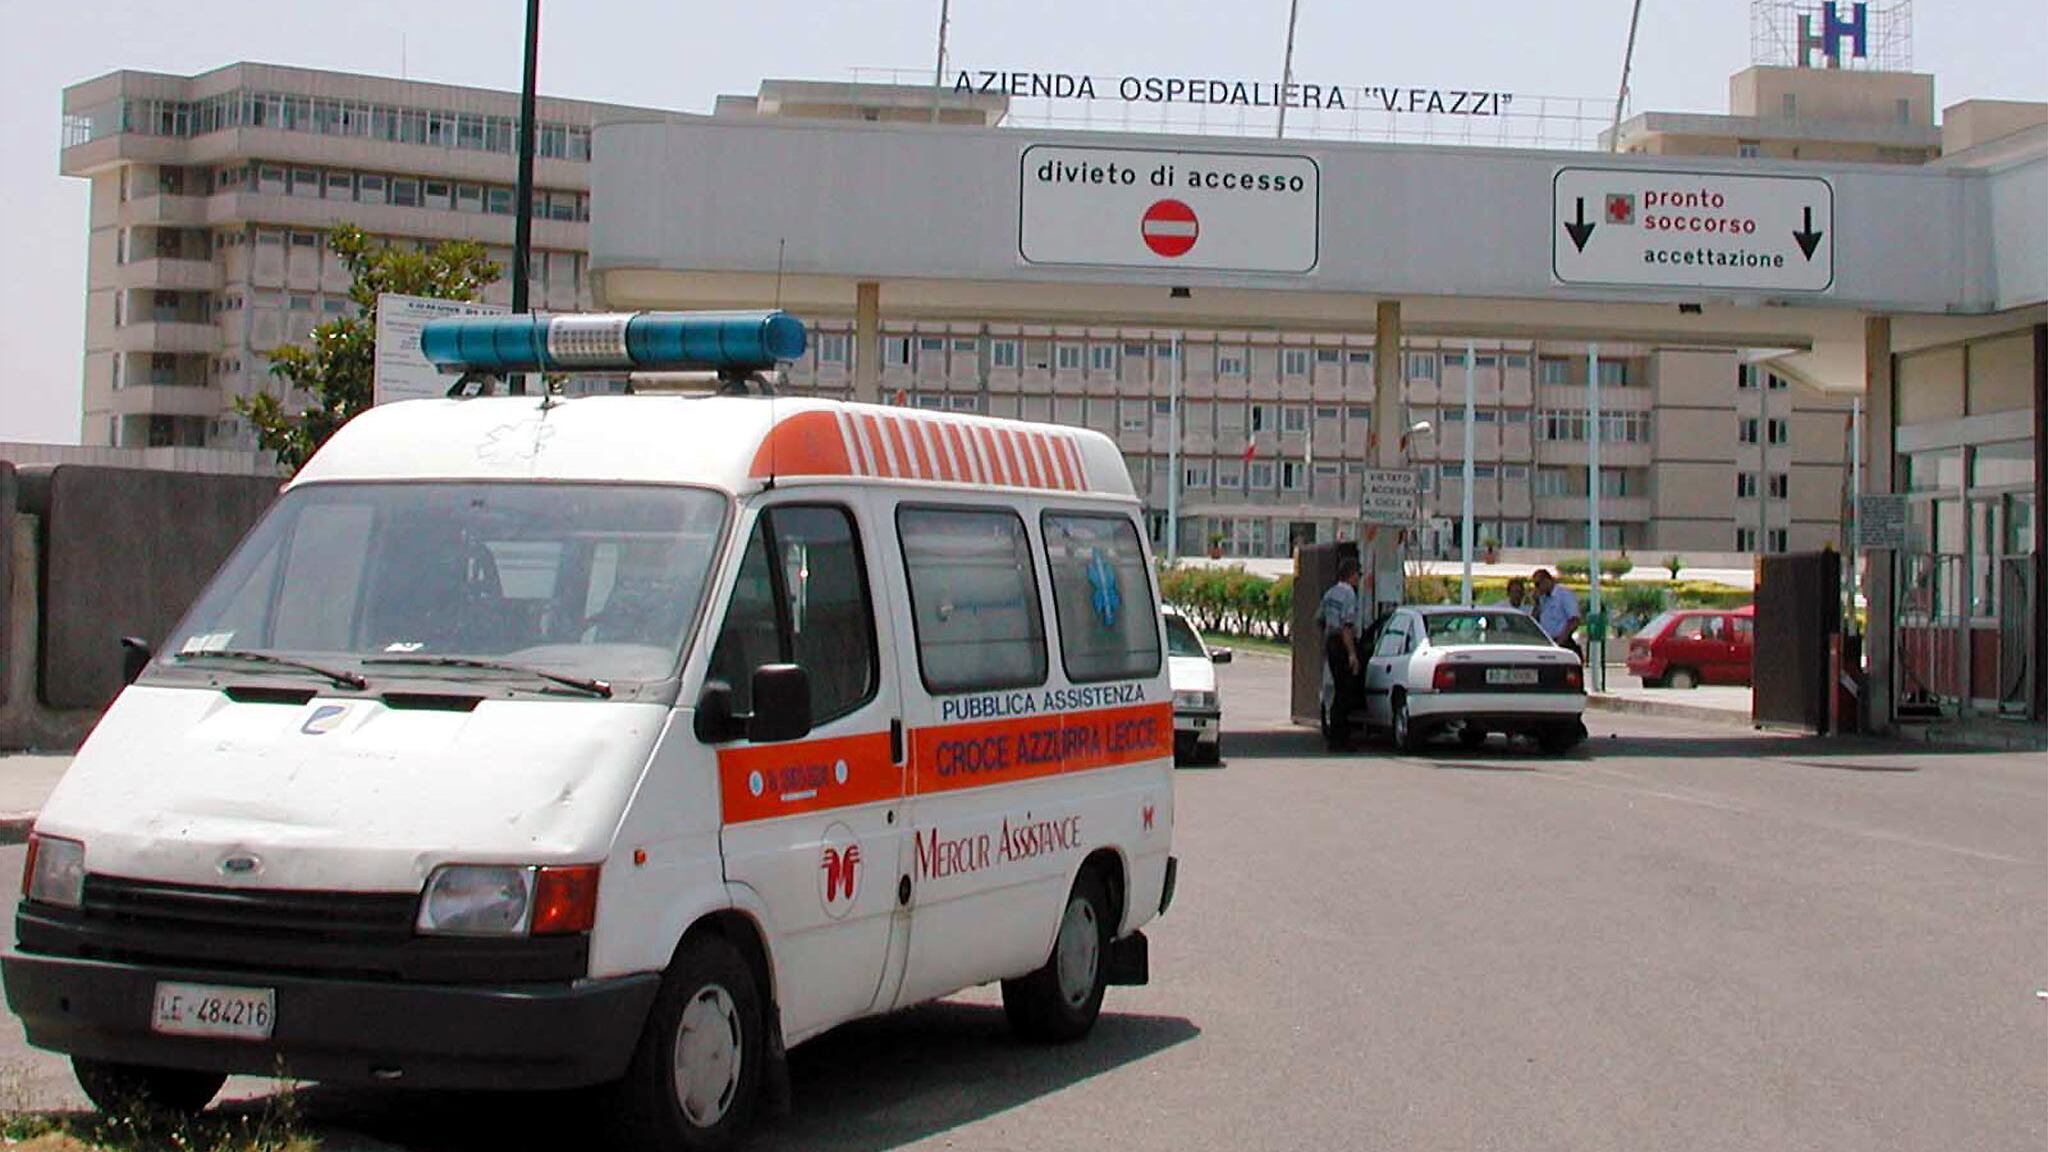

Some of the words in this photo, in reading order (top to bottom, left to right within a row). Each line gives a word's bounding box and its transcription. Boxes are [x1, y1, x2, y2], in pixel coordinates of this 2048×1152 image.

[954, 71, 1095, 99] AZIENDA
[1120, 77, 1345, 110] OSPEDALIERA
[1038, 161, 1136, 185] divieto
[1150, 165, 1174, 187] di
[1188, 170, 1304, 192] accesso
[1644, 188, 1725, 209] pronto
[1644, 214, 1756, 234] soccorso
[1644, 248, 1784, 268] accettazione
[942, 693, 1036, 721] PUBBLICA
[1043, 683, 1146, 711] ASSISTENZA
[936, 734, 1009, 777] CROCE
[1016, 724, 1100, 764] AZZURRA
[1106, 716, 1157, 754] LECCE
[914, 827, 990, 882] MERCUR
